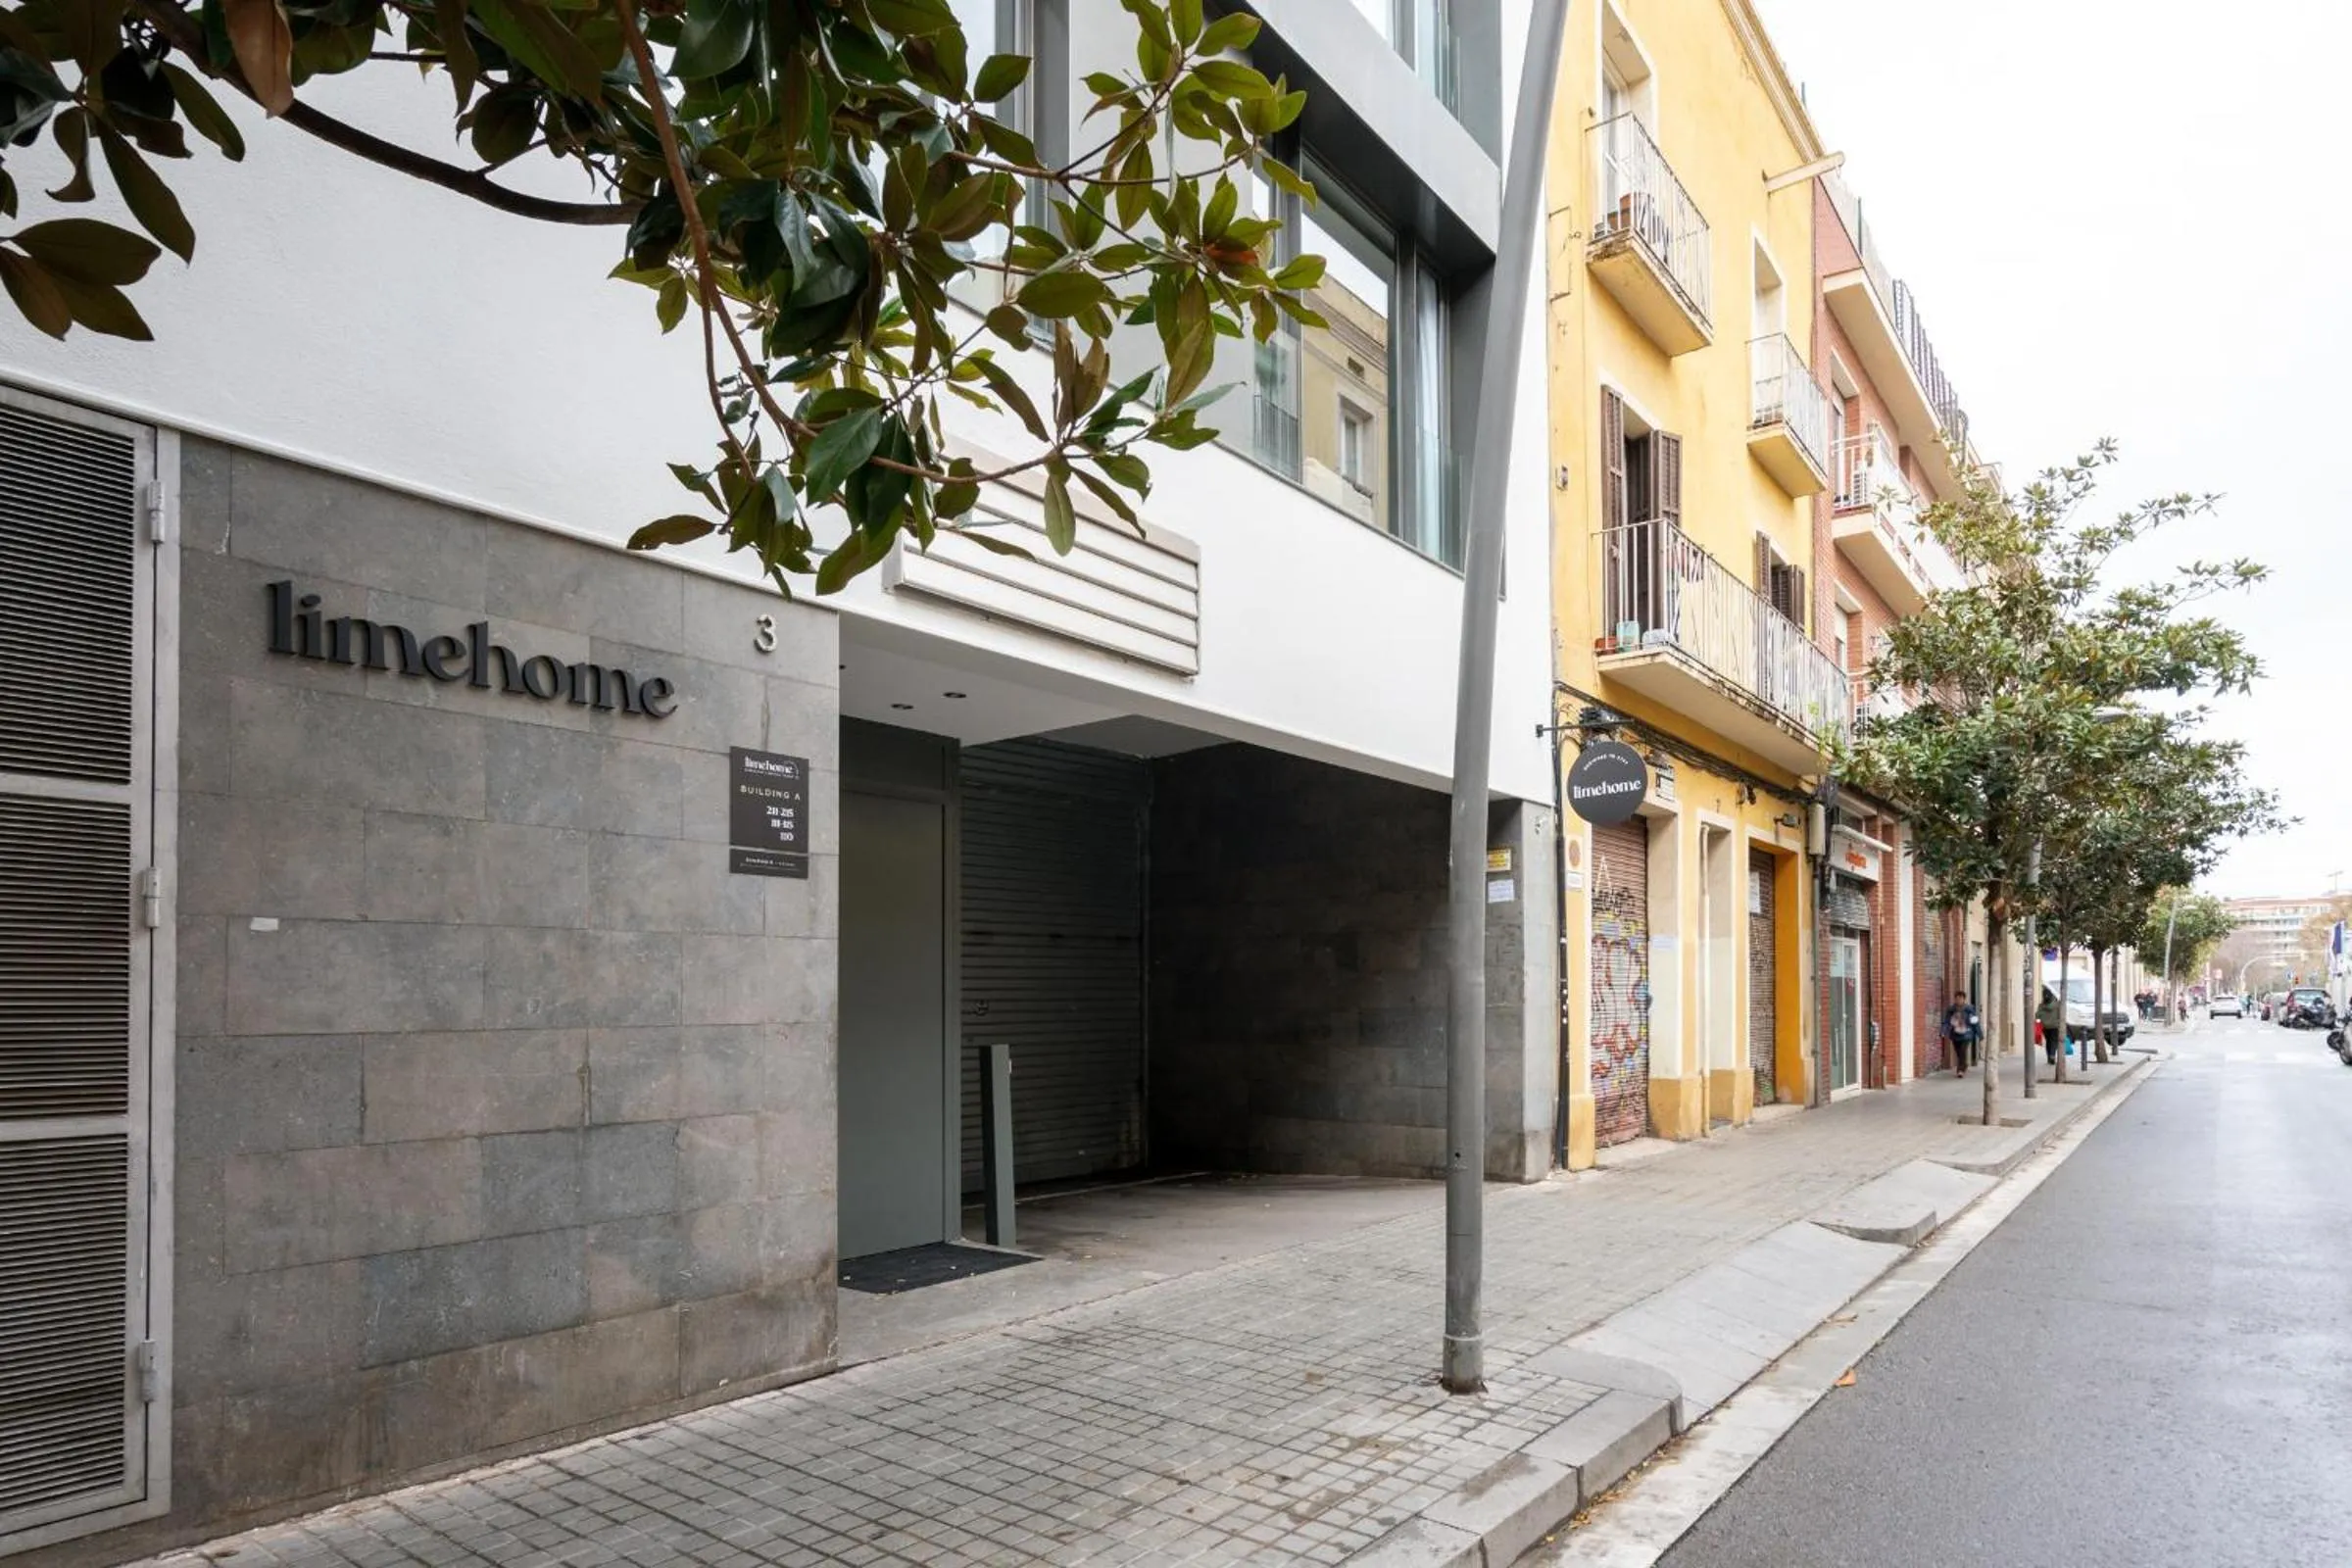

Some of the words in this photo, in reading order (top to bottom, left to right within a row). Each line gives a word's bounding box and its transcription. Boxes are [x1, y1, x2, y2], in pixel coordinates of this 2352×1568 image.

[265, 579, 678, 718] limehome
[754, 613, 777, 654] 3
[741, 784, 790, 800] BUILDING
[1573, 780, 1642, 799] limehome
